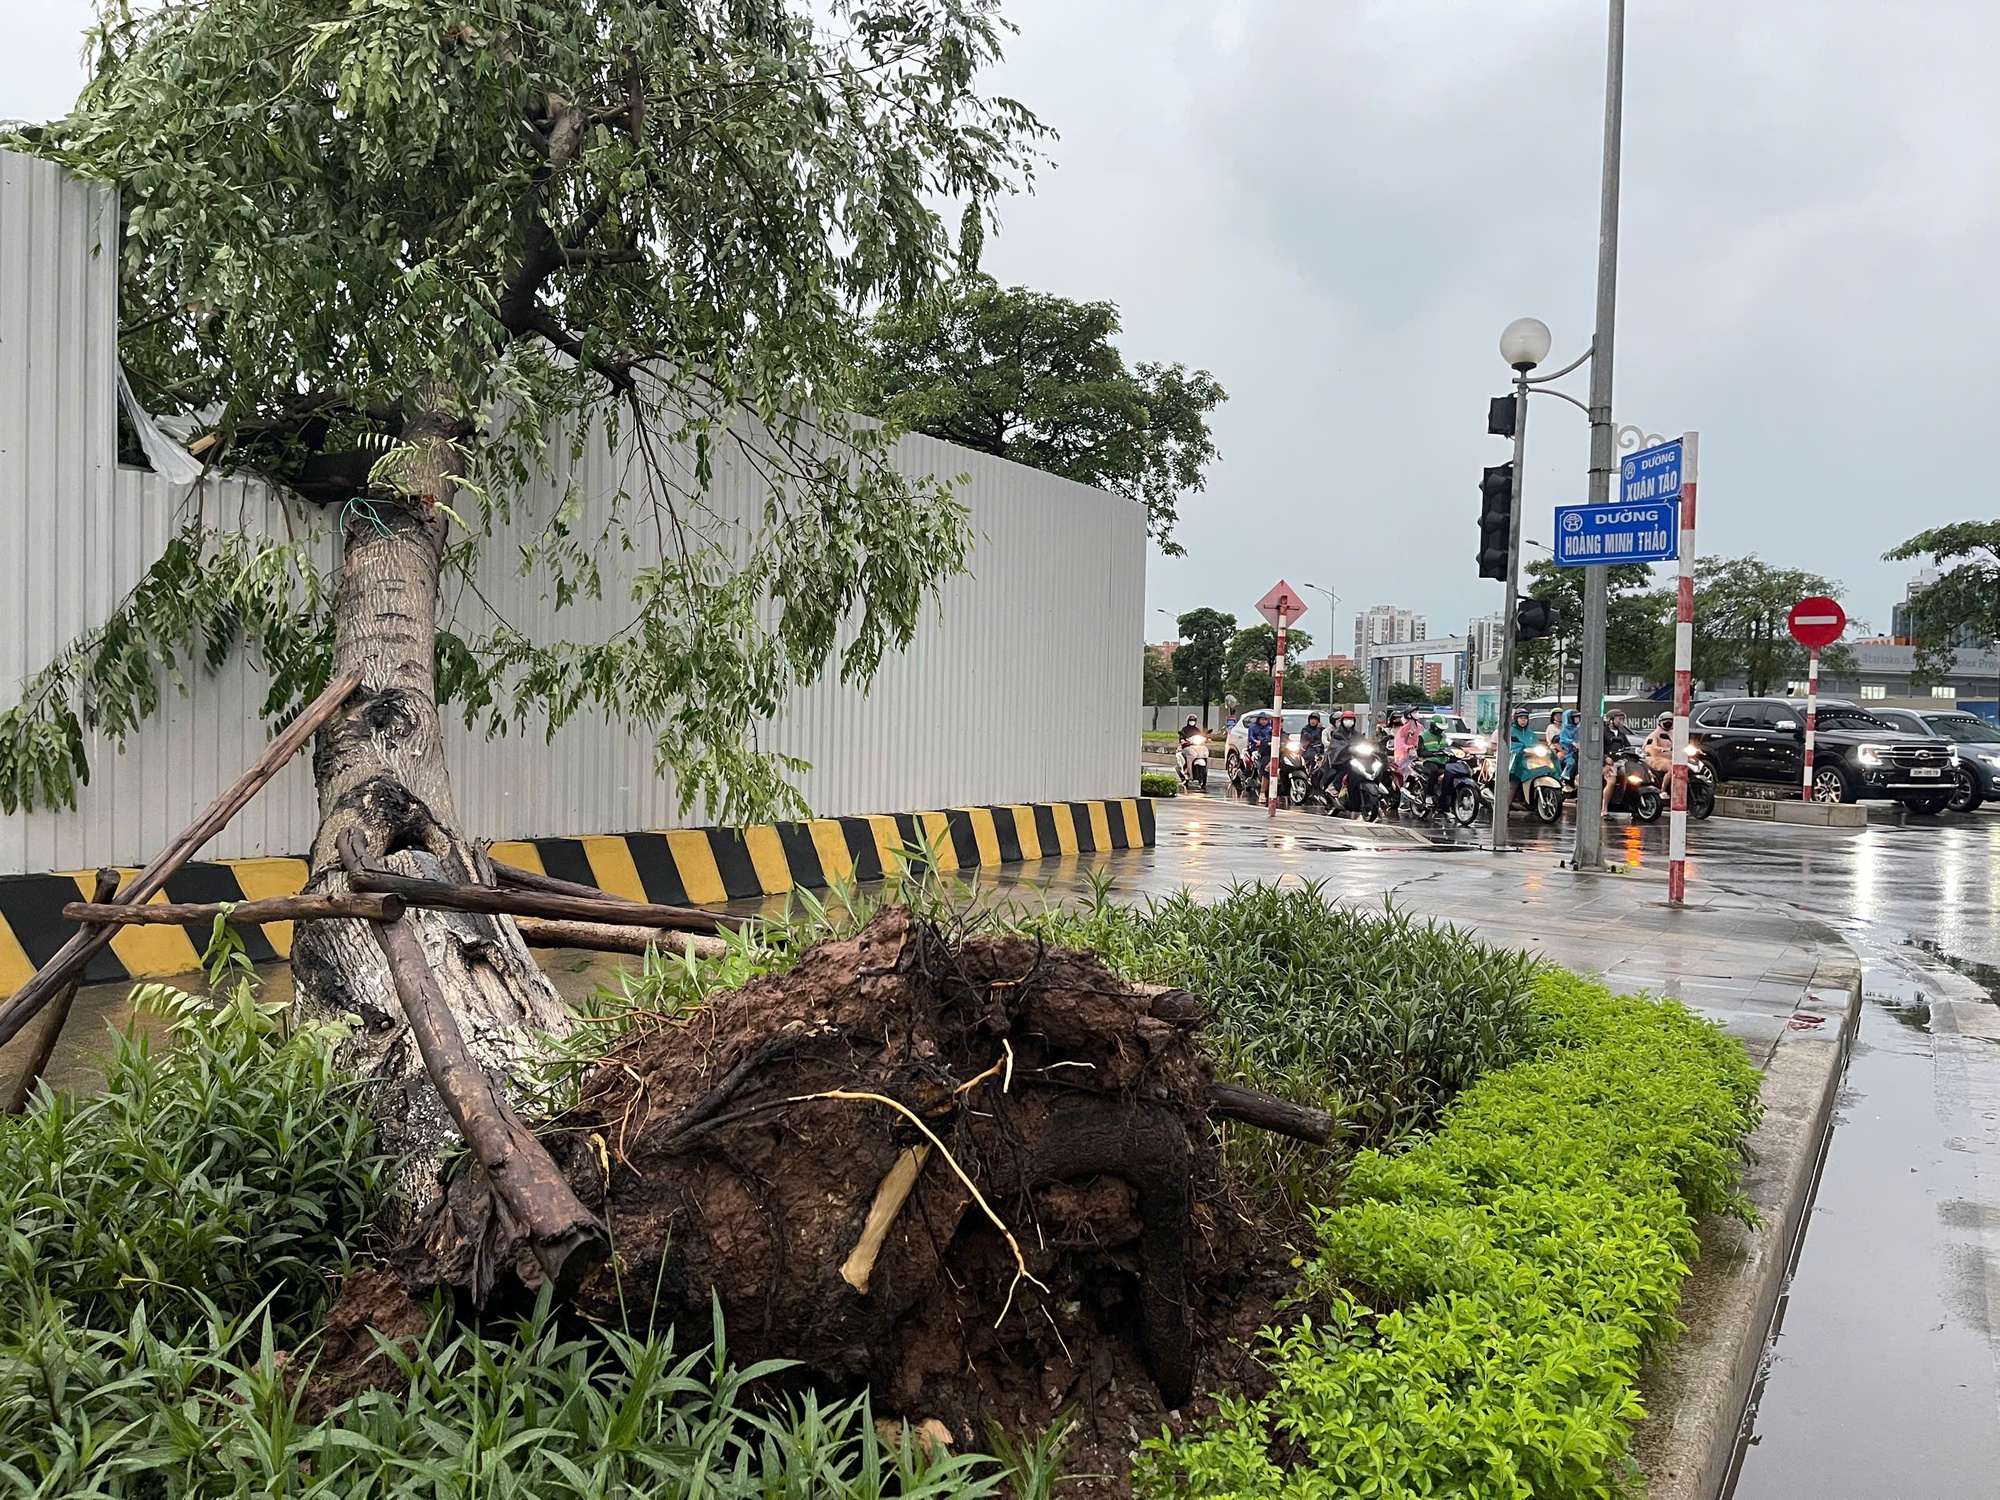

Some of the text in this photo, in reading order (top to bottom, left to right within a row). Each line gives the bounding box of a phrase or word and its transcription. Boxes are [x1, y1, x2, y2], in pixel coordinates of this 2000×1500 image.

[1626, 465, 1677, 502] XUÂN TẢO
[1565, 524, 1667, 556] HOÀNG MINH THẢO
[1642, 714, 1659, 729] CHÍ
